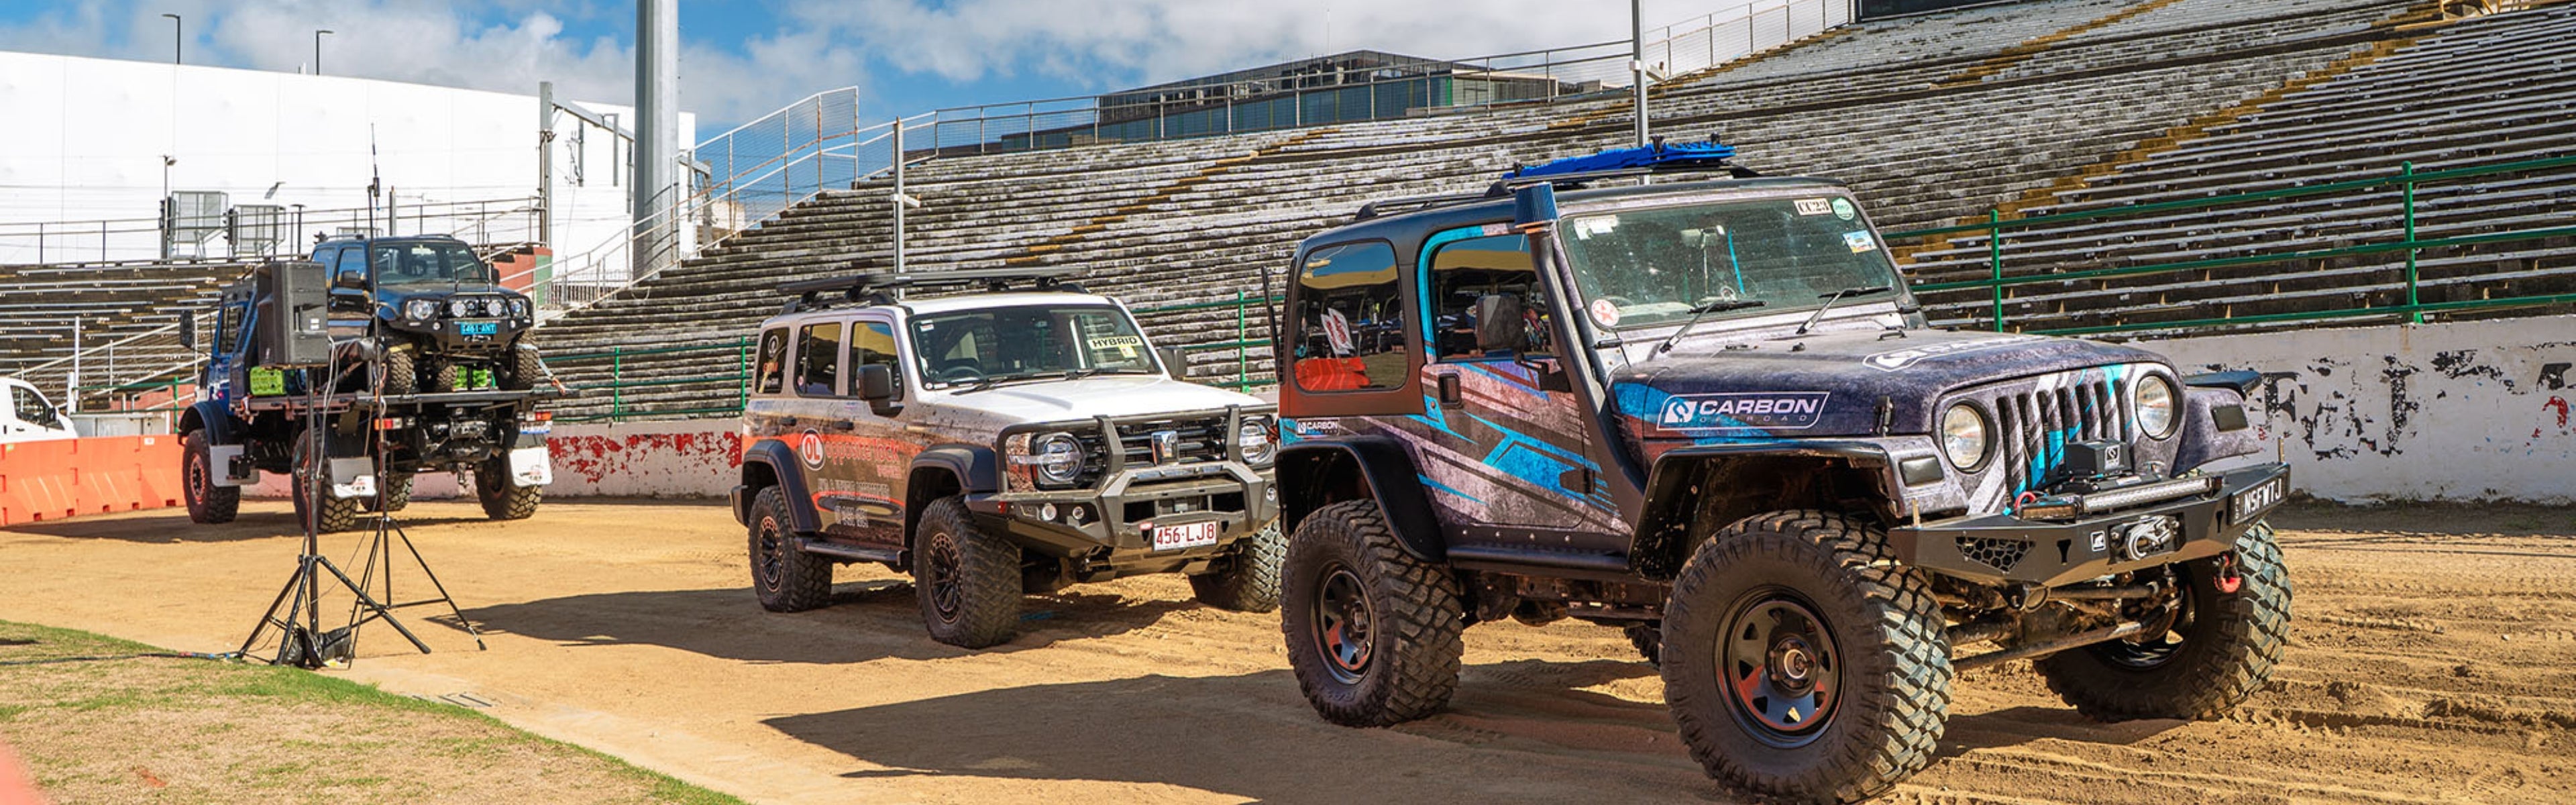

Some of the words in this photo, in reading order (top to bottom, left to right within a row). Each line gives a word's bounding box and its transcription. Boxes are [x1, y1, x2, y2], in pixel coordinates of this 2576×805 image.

[1092, 337, 1137, 347] HYBRID
[1699, 398, 1819, 415] CARBON
[1307, 421, 1338, 429] CARBON
[804, 437, 820, 461] OL
[824, 440, 872, 466] opposite
[873, 437, 900, 462] lock
[2244, 478, 2282, 516] NSFWTJ
